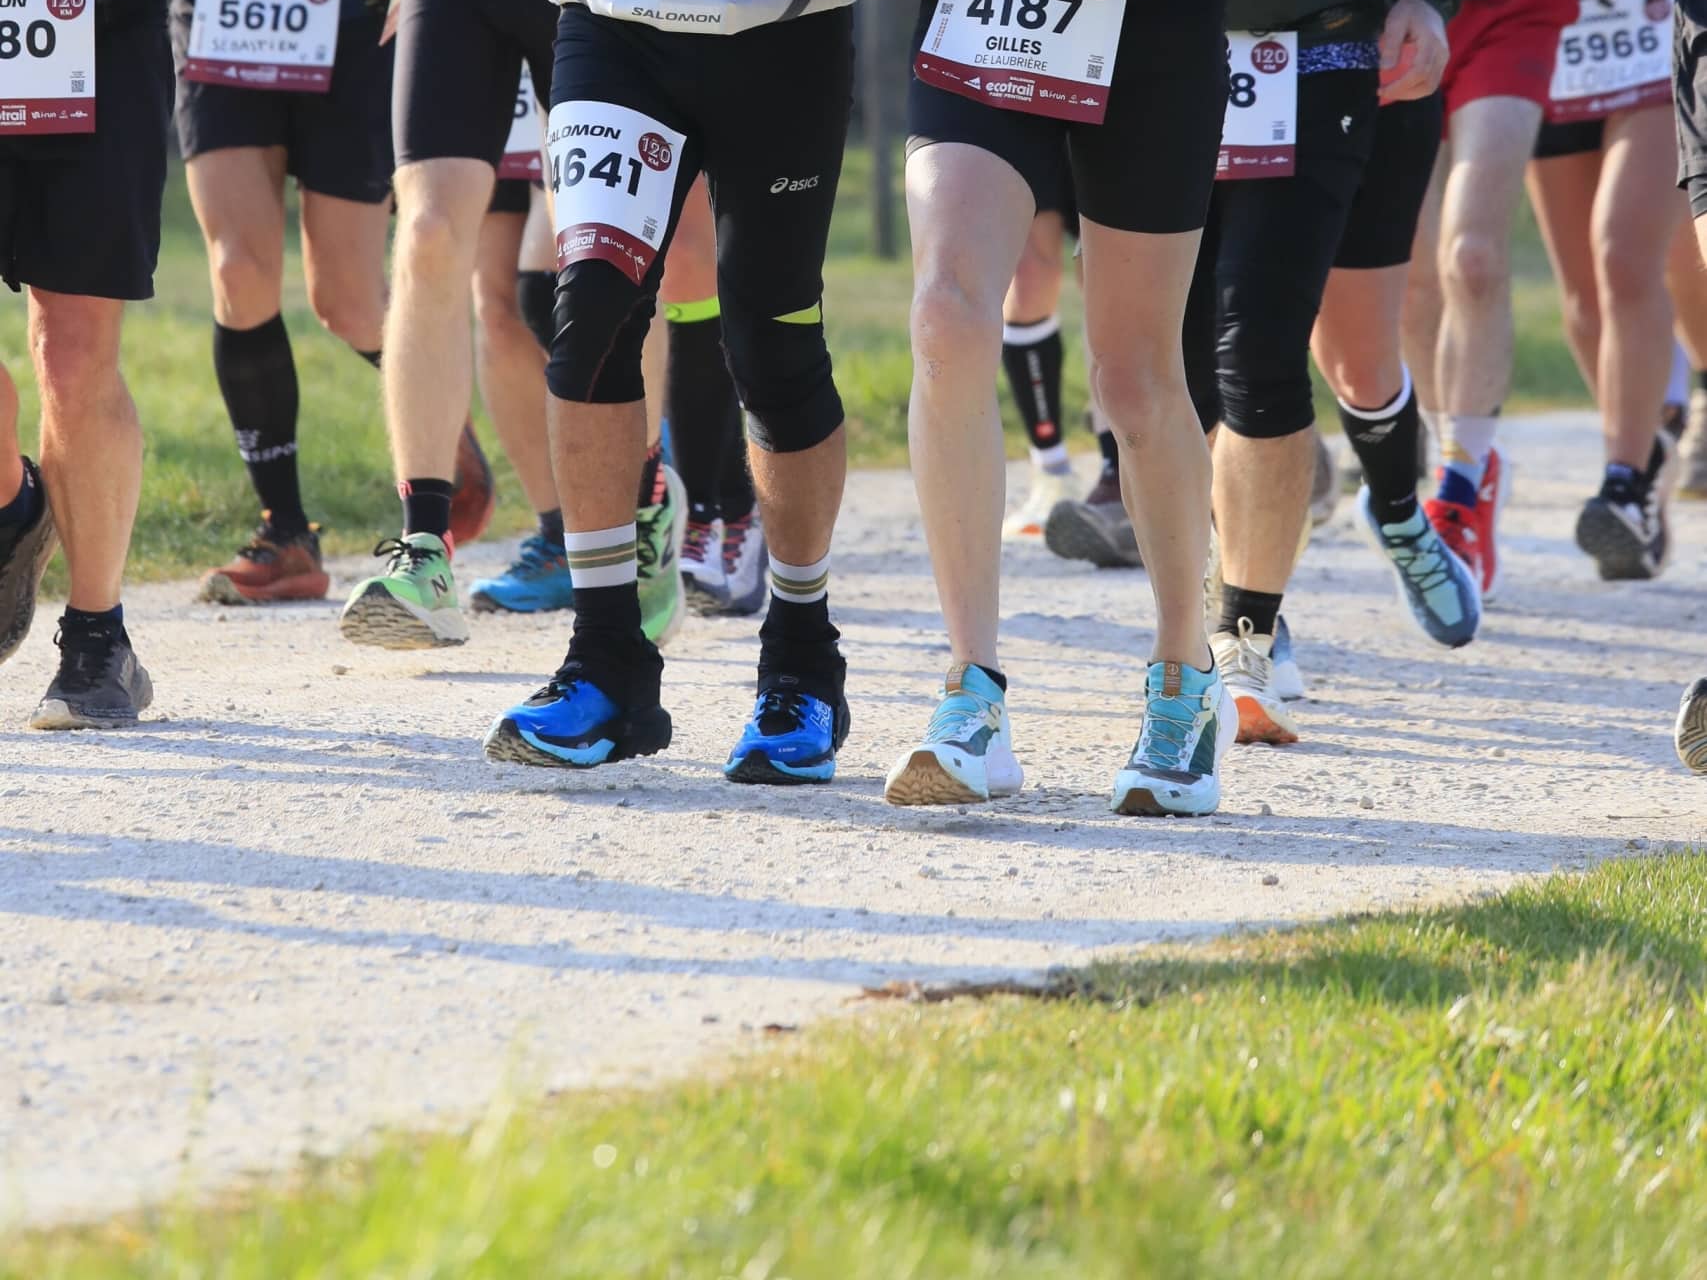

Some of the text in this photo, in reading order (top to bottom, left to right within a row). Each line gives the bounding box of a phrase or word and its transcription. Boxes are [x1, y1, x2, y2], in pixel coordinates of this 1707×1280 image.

[59, 8, 73, 16] KM
[218, 0, 309, 33] 5610
[631, 6, 722, 24] SALOMON
[985, 35, 1042, 56] GILLES
[1563, 25, 1660, 66] 5966
[974, 53, 1049, 72] DE LAUBRIÈRE
[1253, 47, 1287, 64] 120
[985, 81, 1035, 98] ecotrail
[641, 136, 671, 164] 120
[551, 147, 644, 197] 4641
[788, 175, 820, 192] asics
